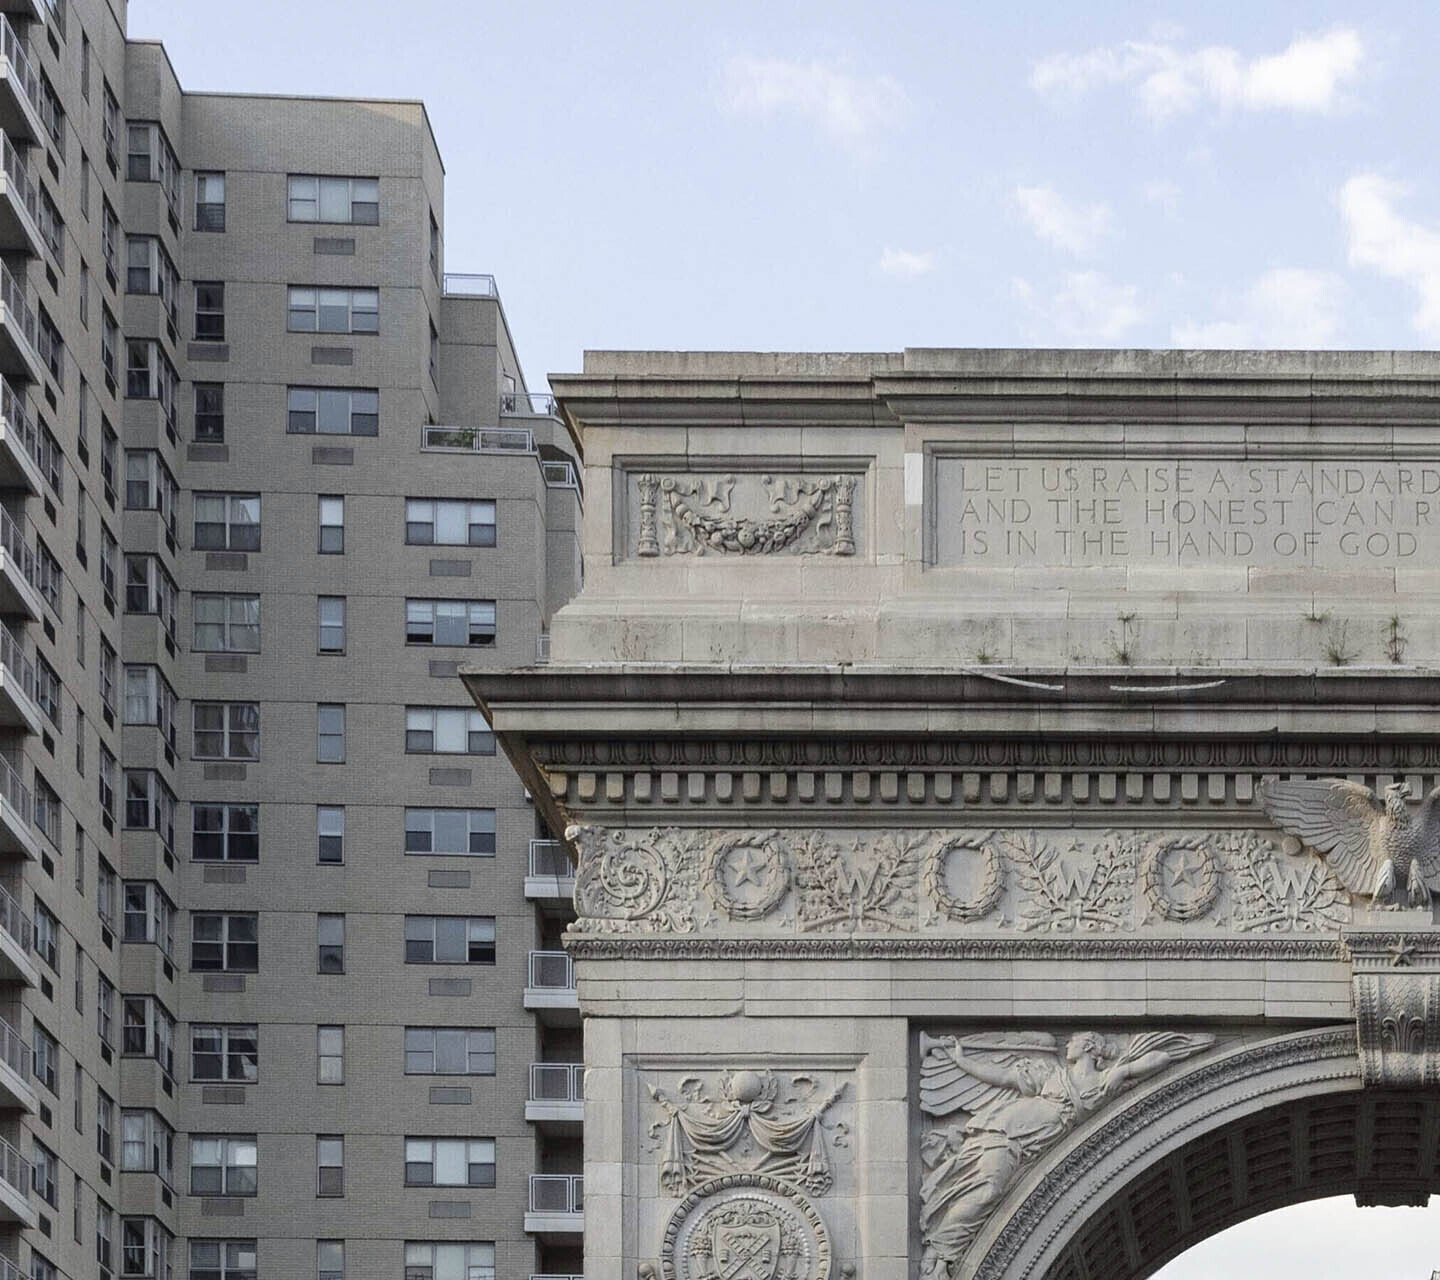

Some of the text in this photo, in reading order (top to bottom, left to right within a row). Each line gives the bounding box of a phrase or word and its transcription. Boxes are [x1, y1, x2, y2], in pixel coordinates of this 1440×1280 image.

[962, 467, 1030, 492] LET
[1042, 467, 1078, 492] US
[1093, 467, 1194, 492] RAISE
[1209, 467, 1233, 492] A
[960, 500, 1031, 524] AND
[1049, 500, 1121, 524] THE
[1146, 500, 1293, 525] HONEST
[1317, 500, 1393, 525] CAN
[962, 531, 988, 555] IS
[1007, 531, 1037, 555] IN
[1055, 531, 1129, 556] THE
[1151, 531, 1253, 556] HAND
[1274, 532, 1321, 556] OF
[1339, 531, 1417, 556] GOD
